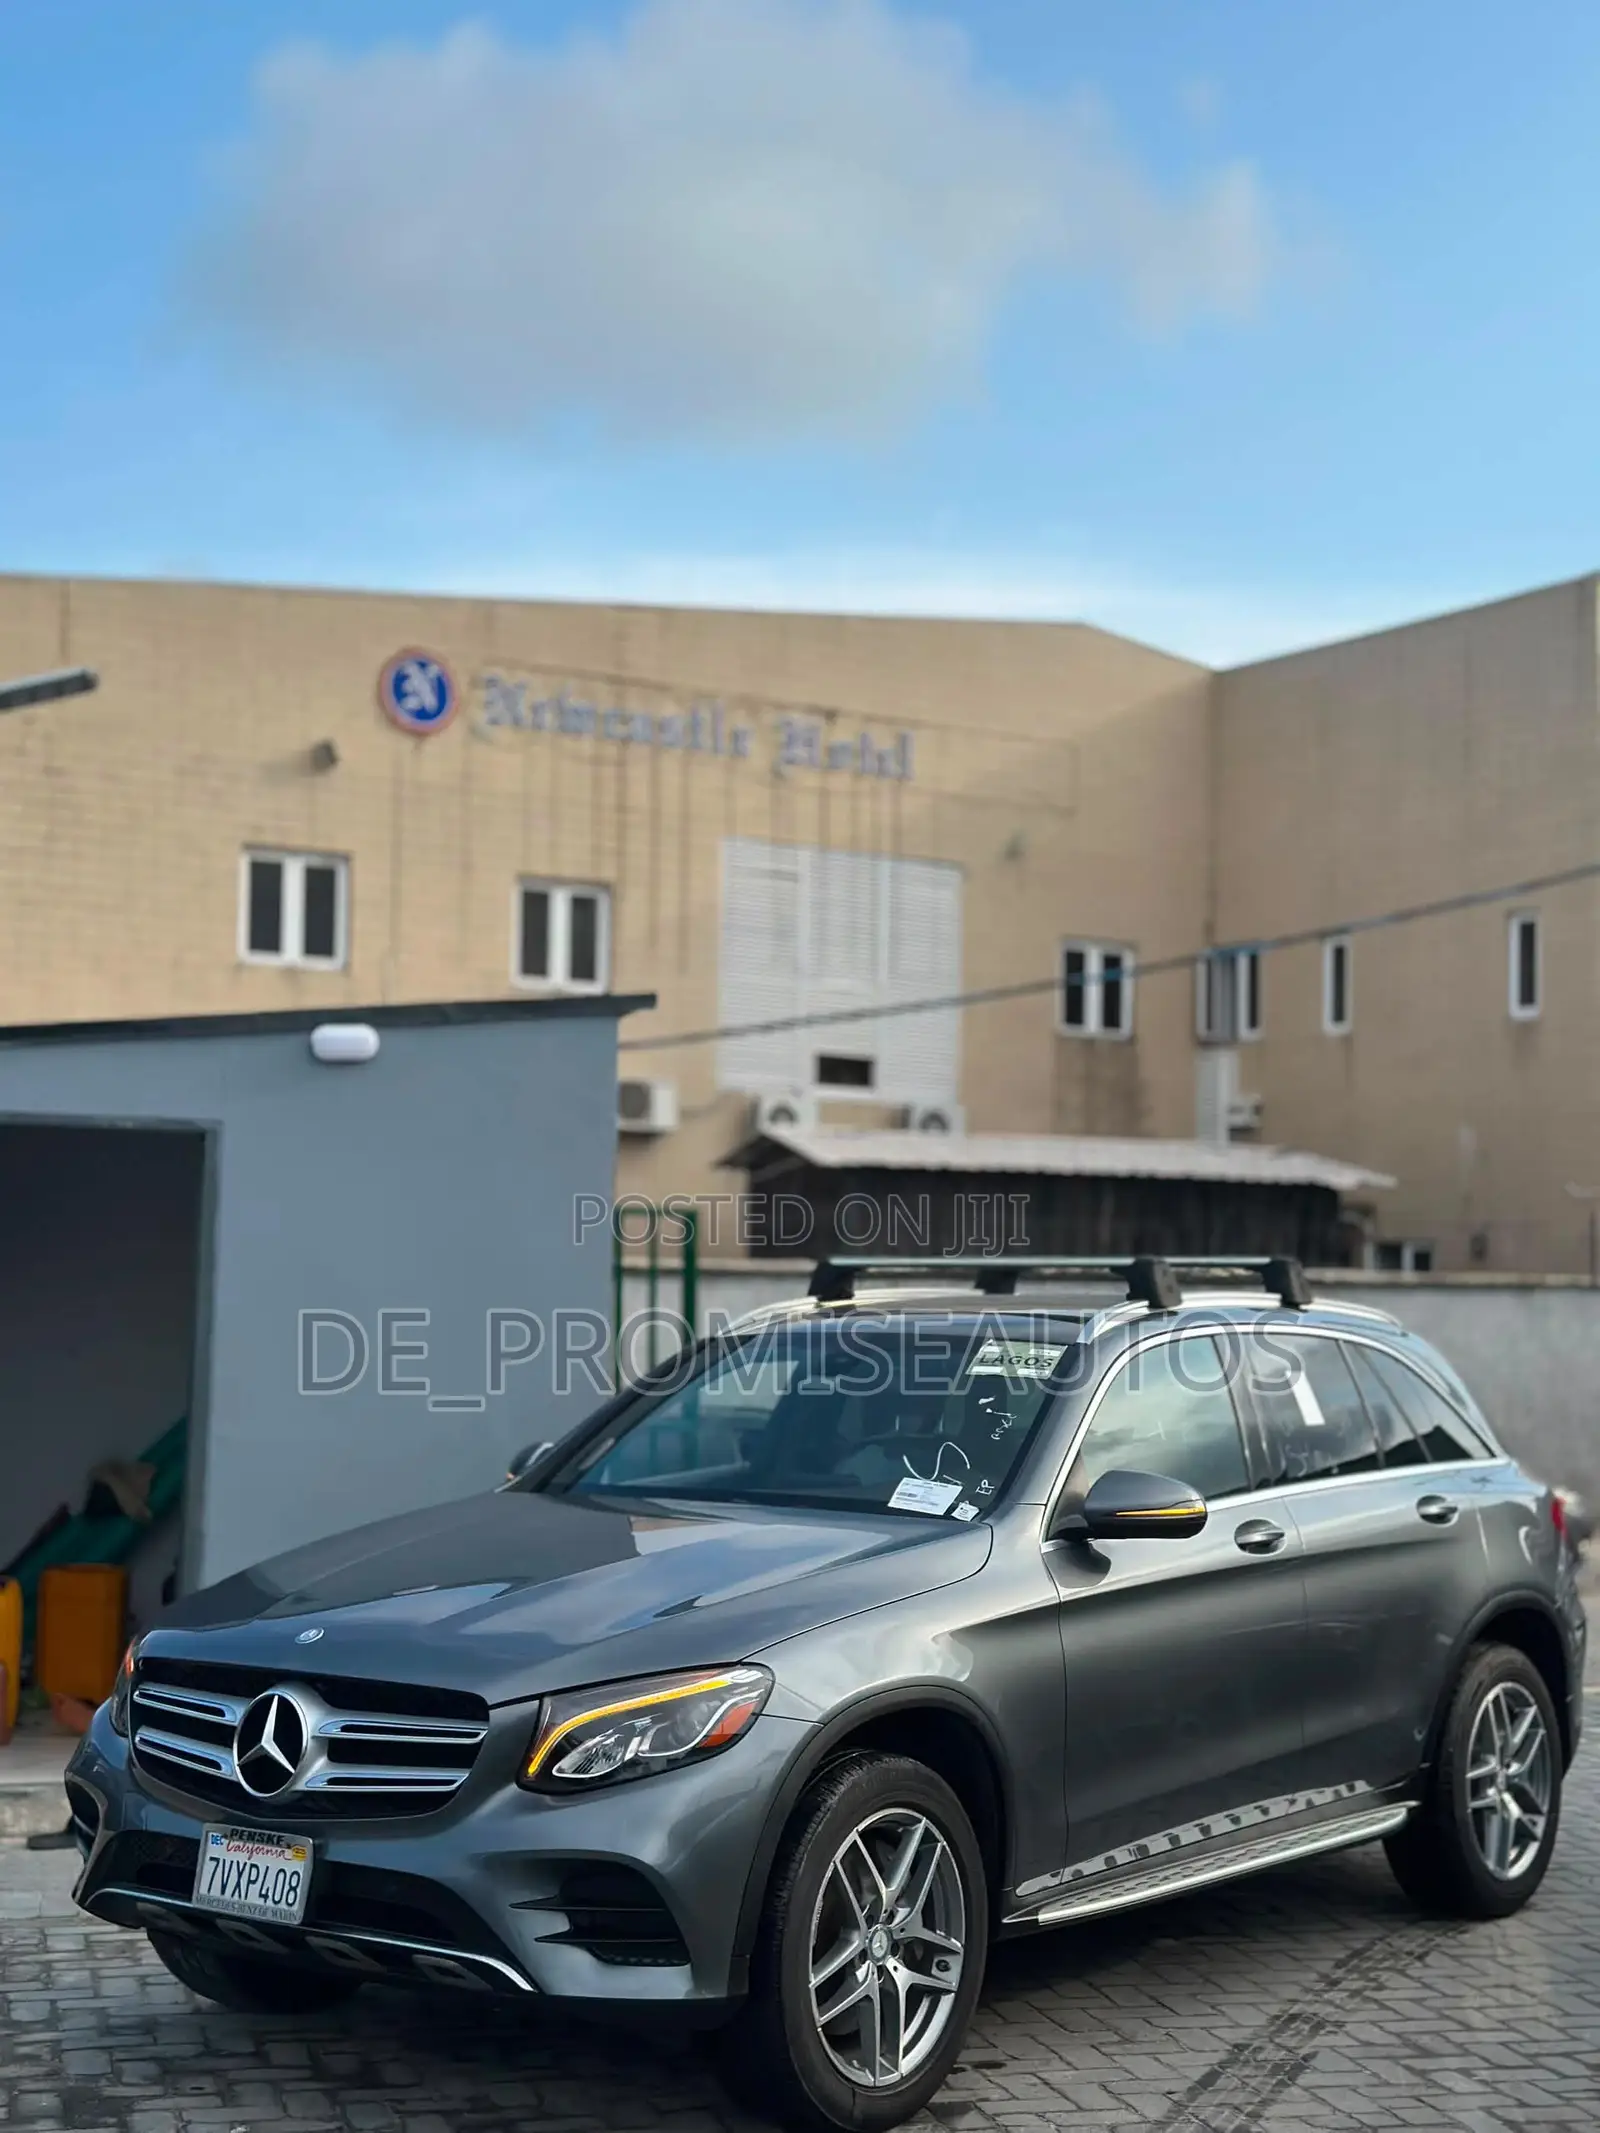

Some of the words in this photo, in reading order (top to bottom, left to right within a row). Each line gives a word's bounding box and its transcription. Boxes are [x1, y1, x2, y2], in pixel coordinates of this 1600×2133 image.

[978, 1355, 1054, 1368] LAGOS
[229, 1828, 285, 1846] PENSKE
[207, 1856, 301, 1907] 7VXP408
